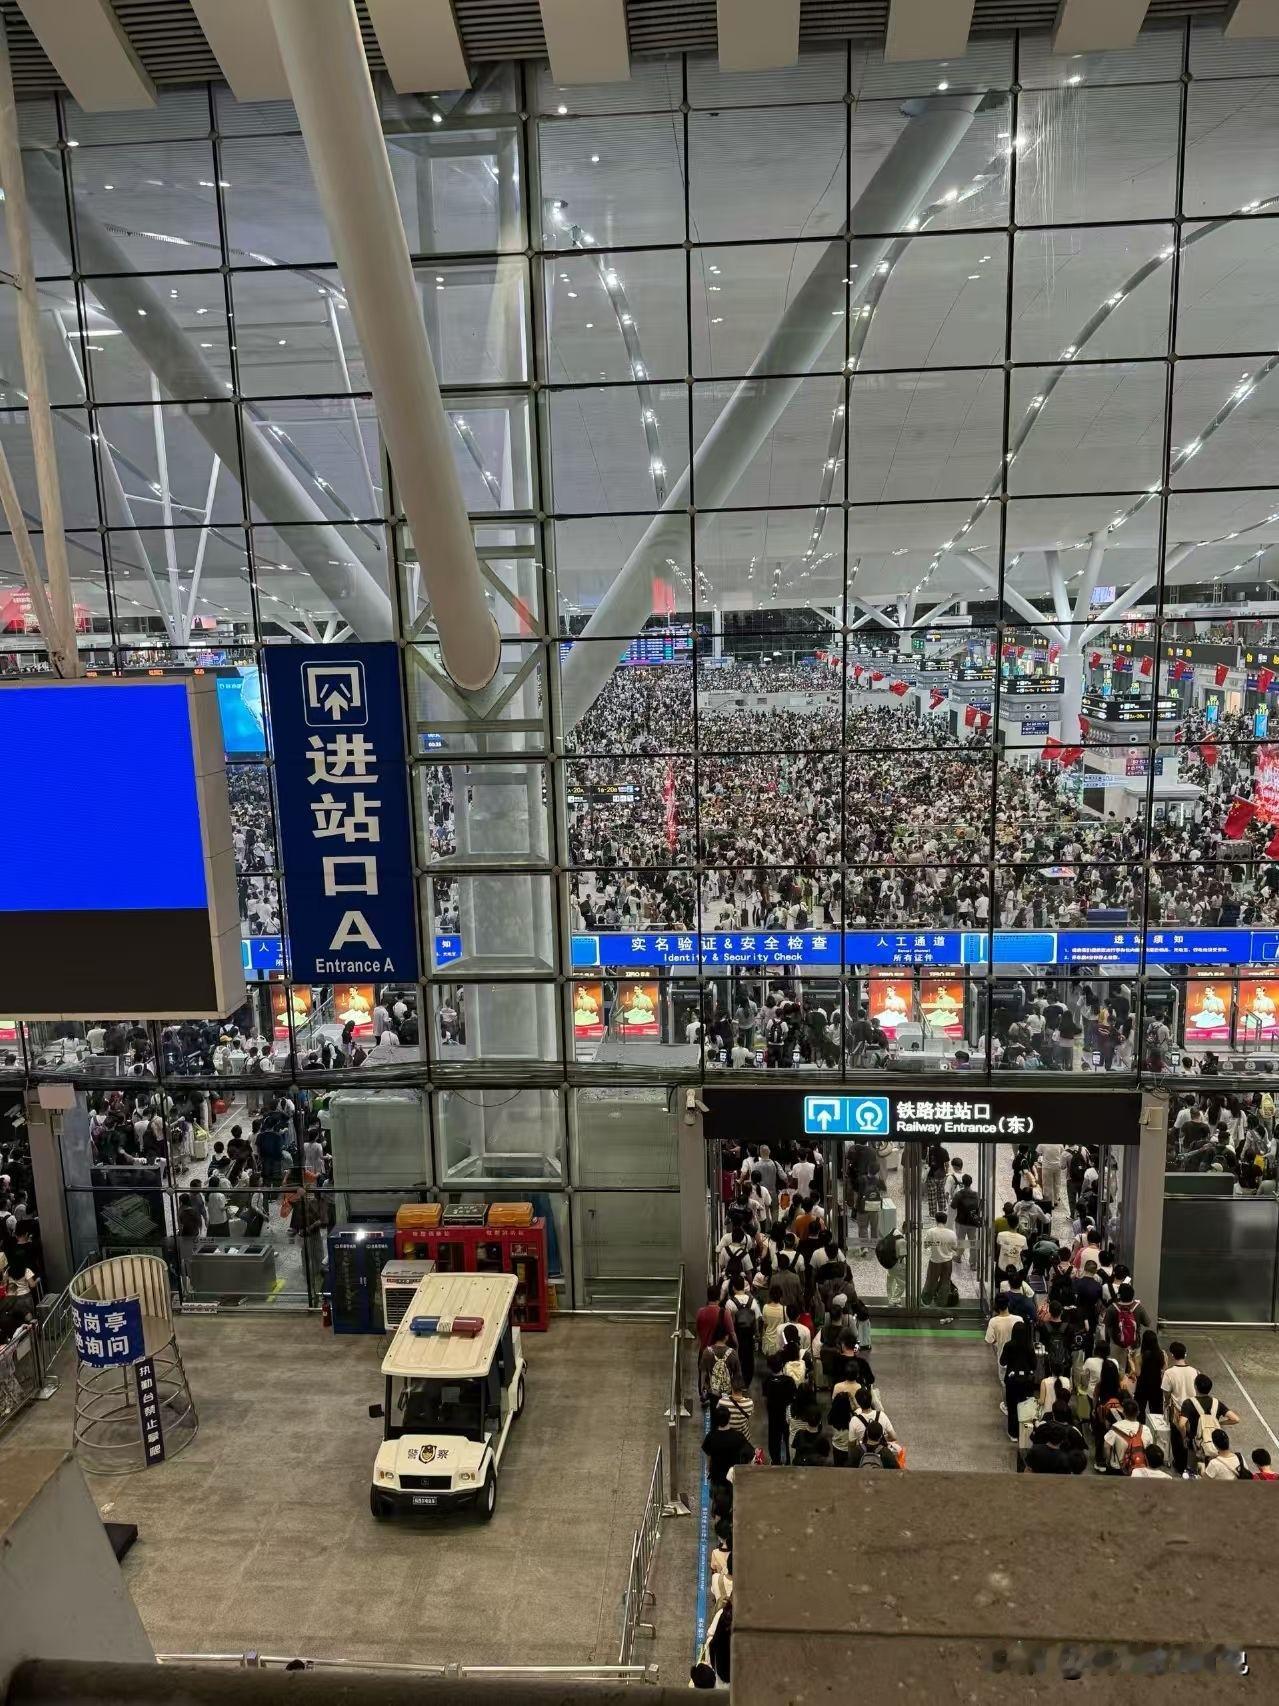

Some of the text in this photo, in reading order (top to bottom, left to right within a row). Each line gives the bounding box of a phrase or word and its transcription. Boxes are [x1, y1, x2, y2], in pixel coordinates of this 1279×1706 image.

[877, 936, 945, 947] 人工通道
[316, 957, 395, 973] Entrance A
[712, 953, 719, 961] &
[723, 953, 769, 963] Security
[774, 953, 803, 961] Check
[896, 1101, 991, 1120] 铁路进站口
[896, 1121, 997, 1135] Railway Entrance
